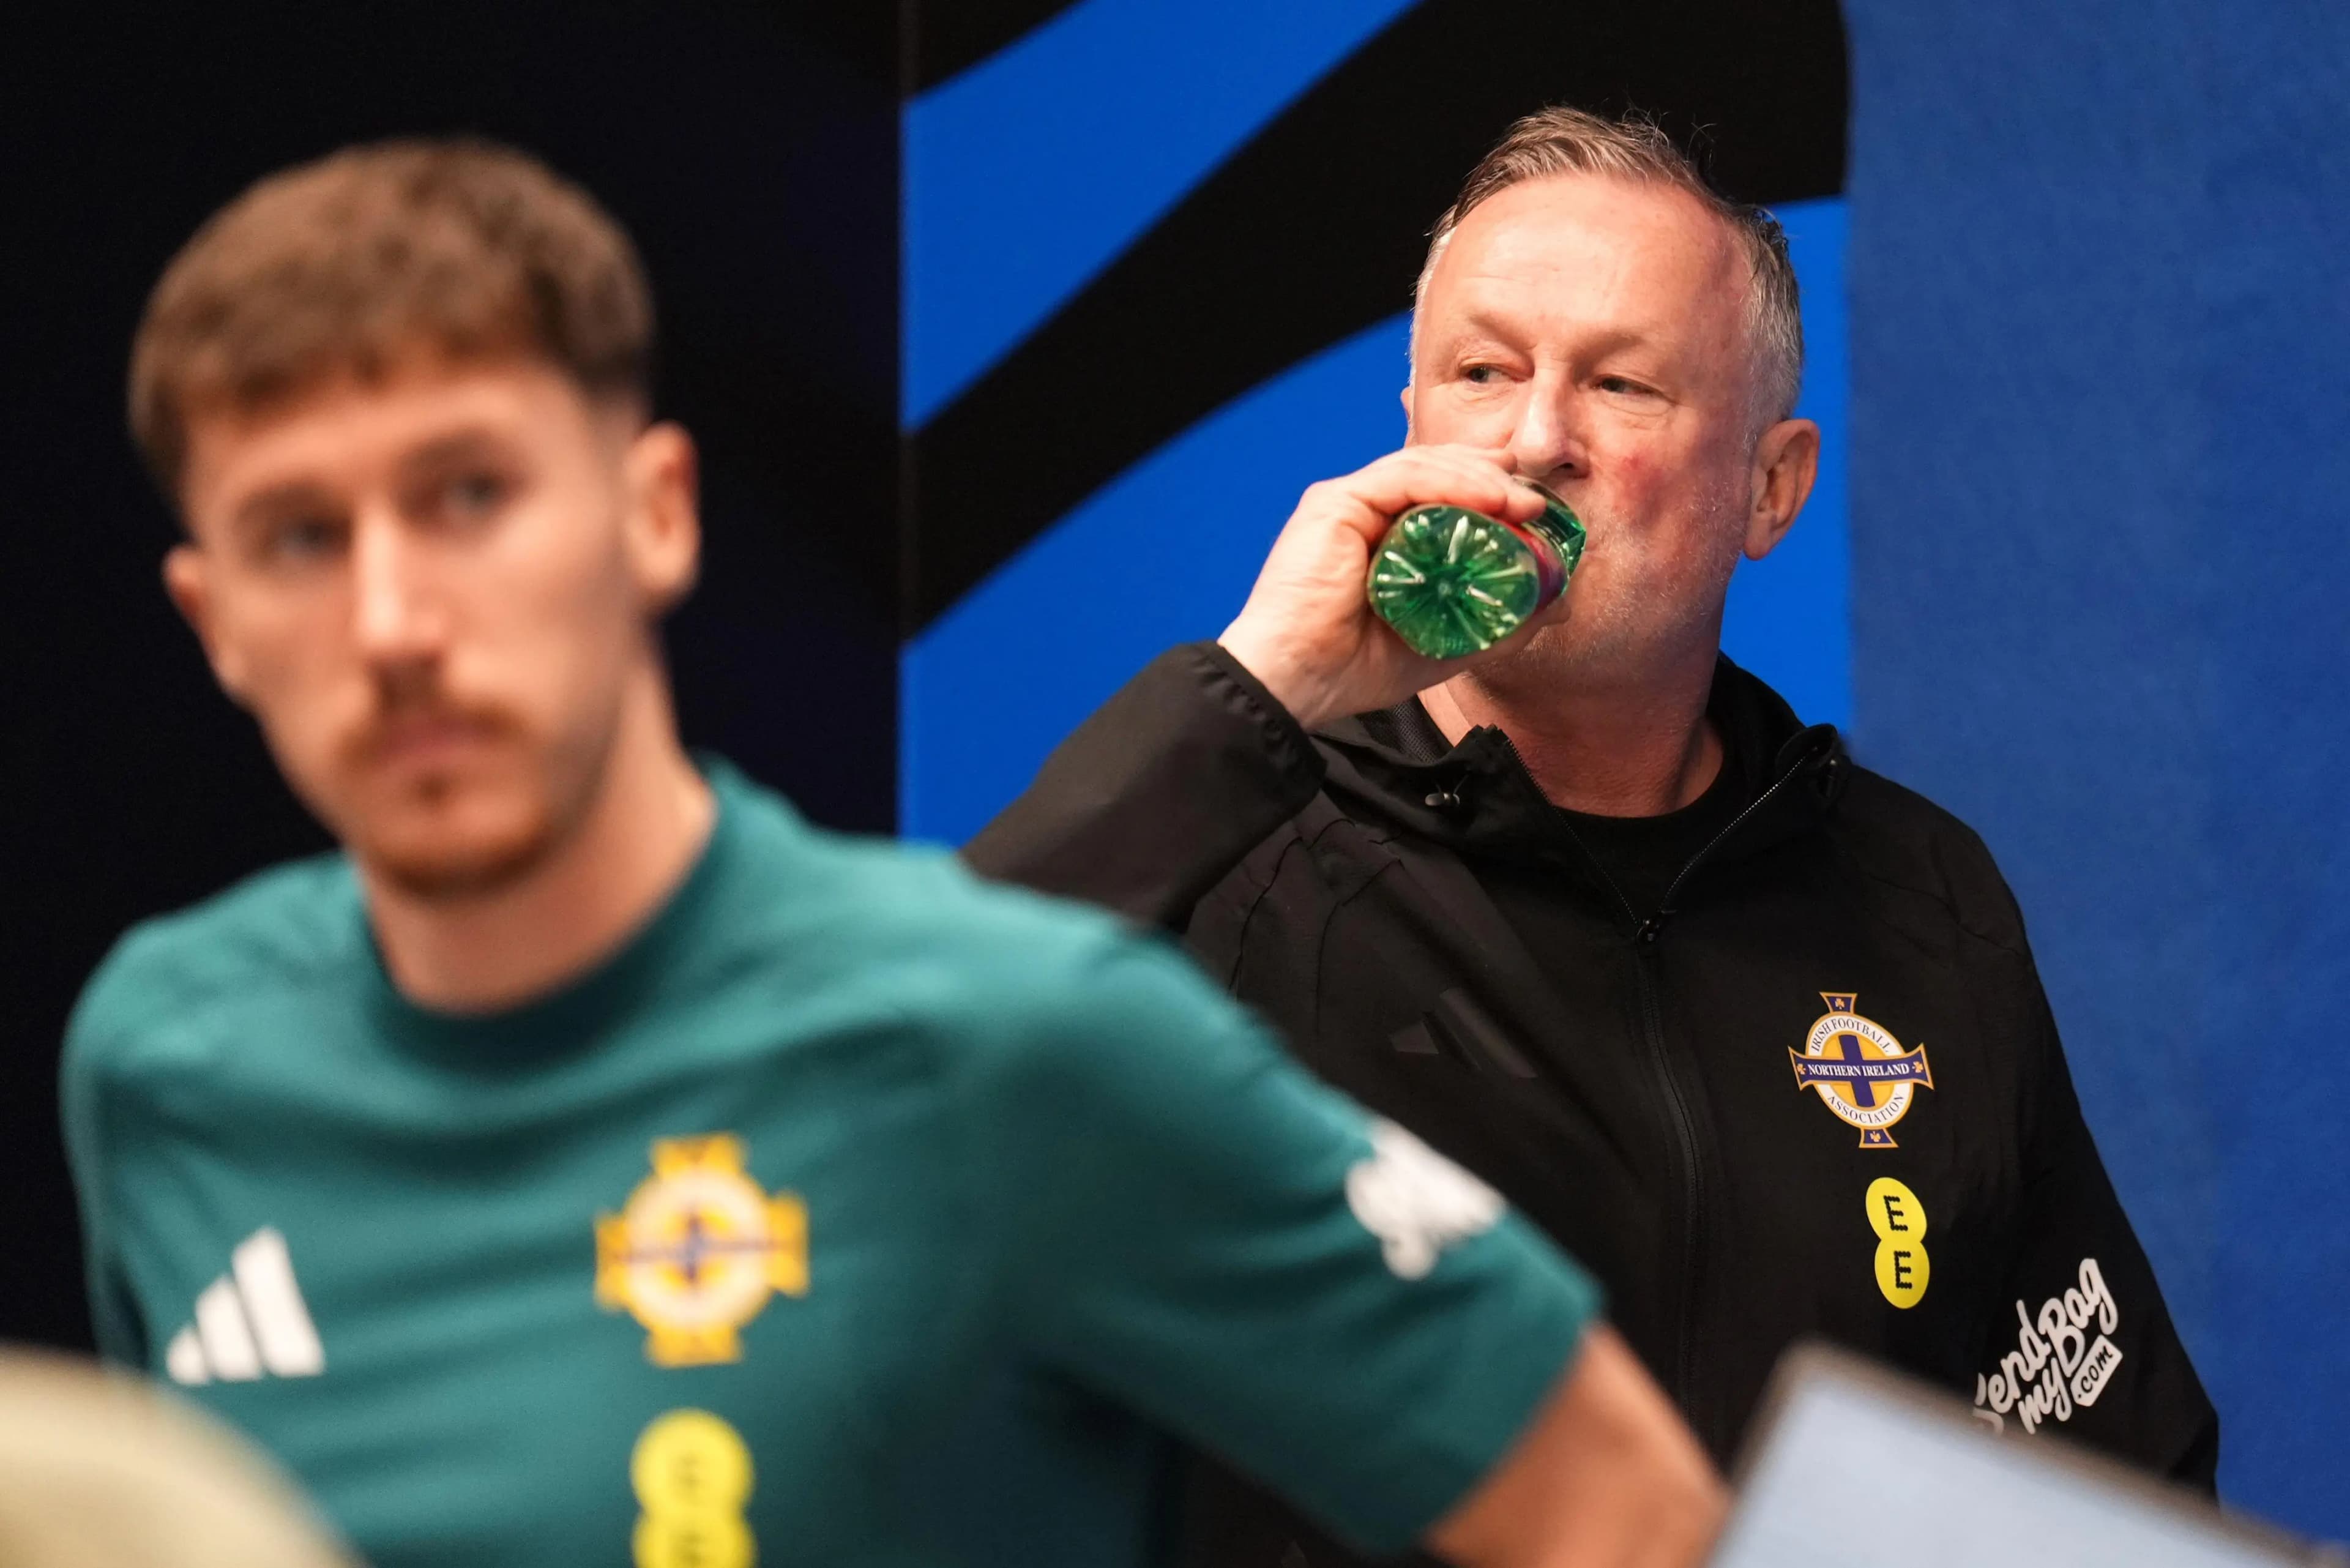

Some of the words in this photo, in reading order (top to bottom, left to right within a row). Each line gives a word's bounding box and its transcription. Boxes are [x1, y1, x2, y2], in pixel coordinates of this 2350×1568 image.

[1811, 1022, 1831, 1052] IRISH
[1830, 1018, 1889, 1053] FOOTBALL
[1808, 1064, 1861, 1076] NORTHERN
[1862, 1063, 1909, 1076] IRELAND
[1827, 1093, 1904, 1124] ASSOCIATION
[2018, 1357, 2072, 1435] my
